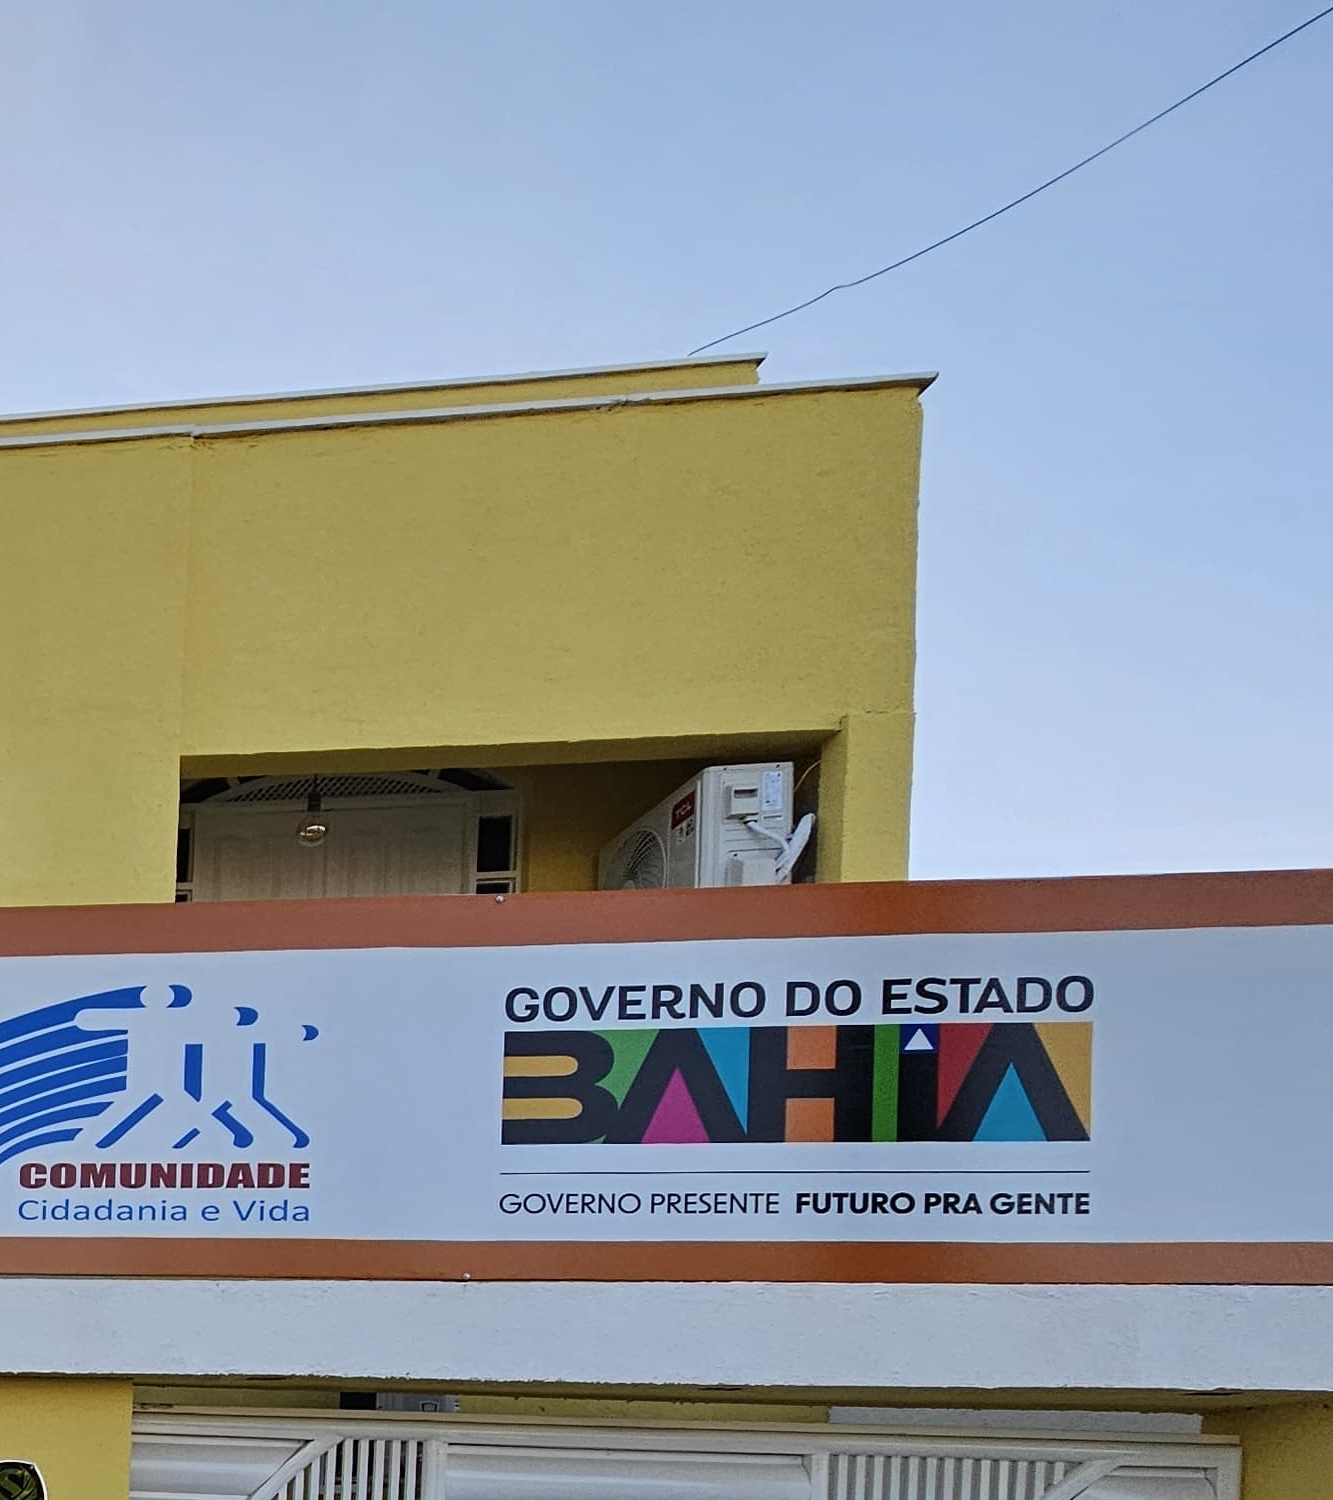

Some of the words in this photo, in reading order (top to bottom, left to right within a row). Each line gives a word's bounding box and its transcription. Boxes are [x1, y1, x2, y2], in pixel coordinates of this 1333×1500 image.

[504, 981, 766, 1023] GOVERNO
[785, 979, 862, 1018] DO
[881, 975, 1095, 1016] ESTADO
[502, 1021, 1092, 1145] BAHIA
[18, 1162, 312, 1190] COMUNIDADE
[18, 1197, 189, 1222] Cidadania
[200, 1204, 221, 1222] e
[232, 1198, 311, 1222] Vida
[499, 1192, 643, 1215] GOVERNO
[650, 1192, 781, 1215] PRESENTE
[795, 1192, 916, 1215] FUTURO
[923, 1192, 983, 1215] PRA
[989, 1191, 1091, 1215] GENTE
